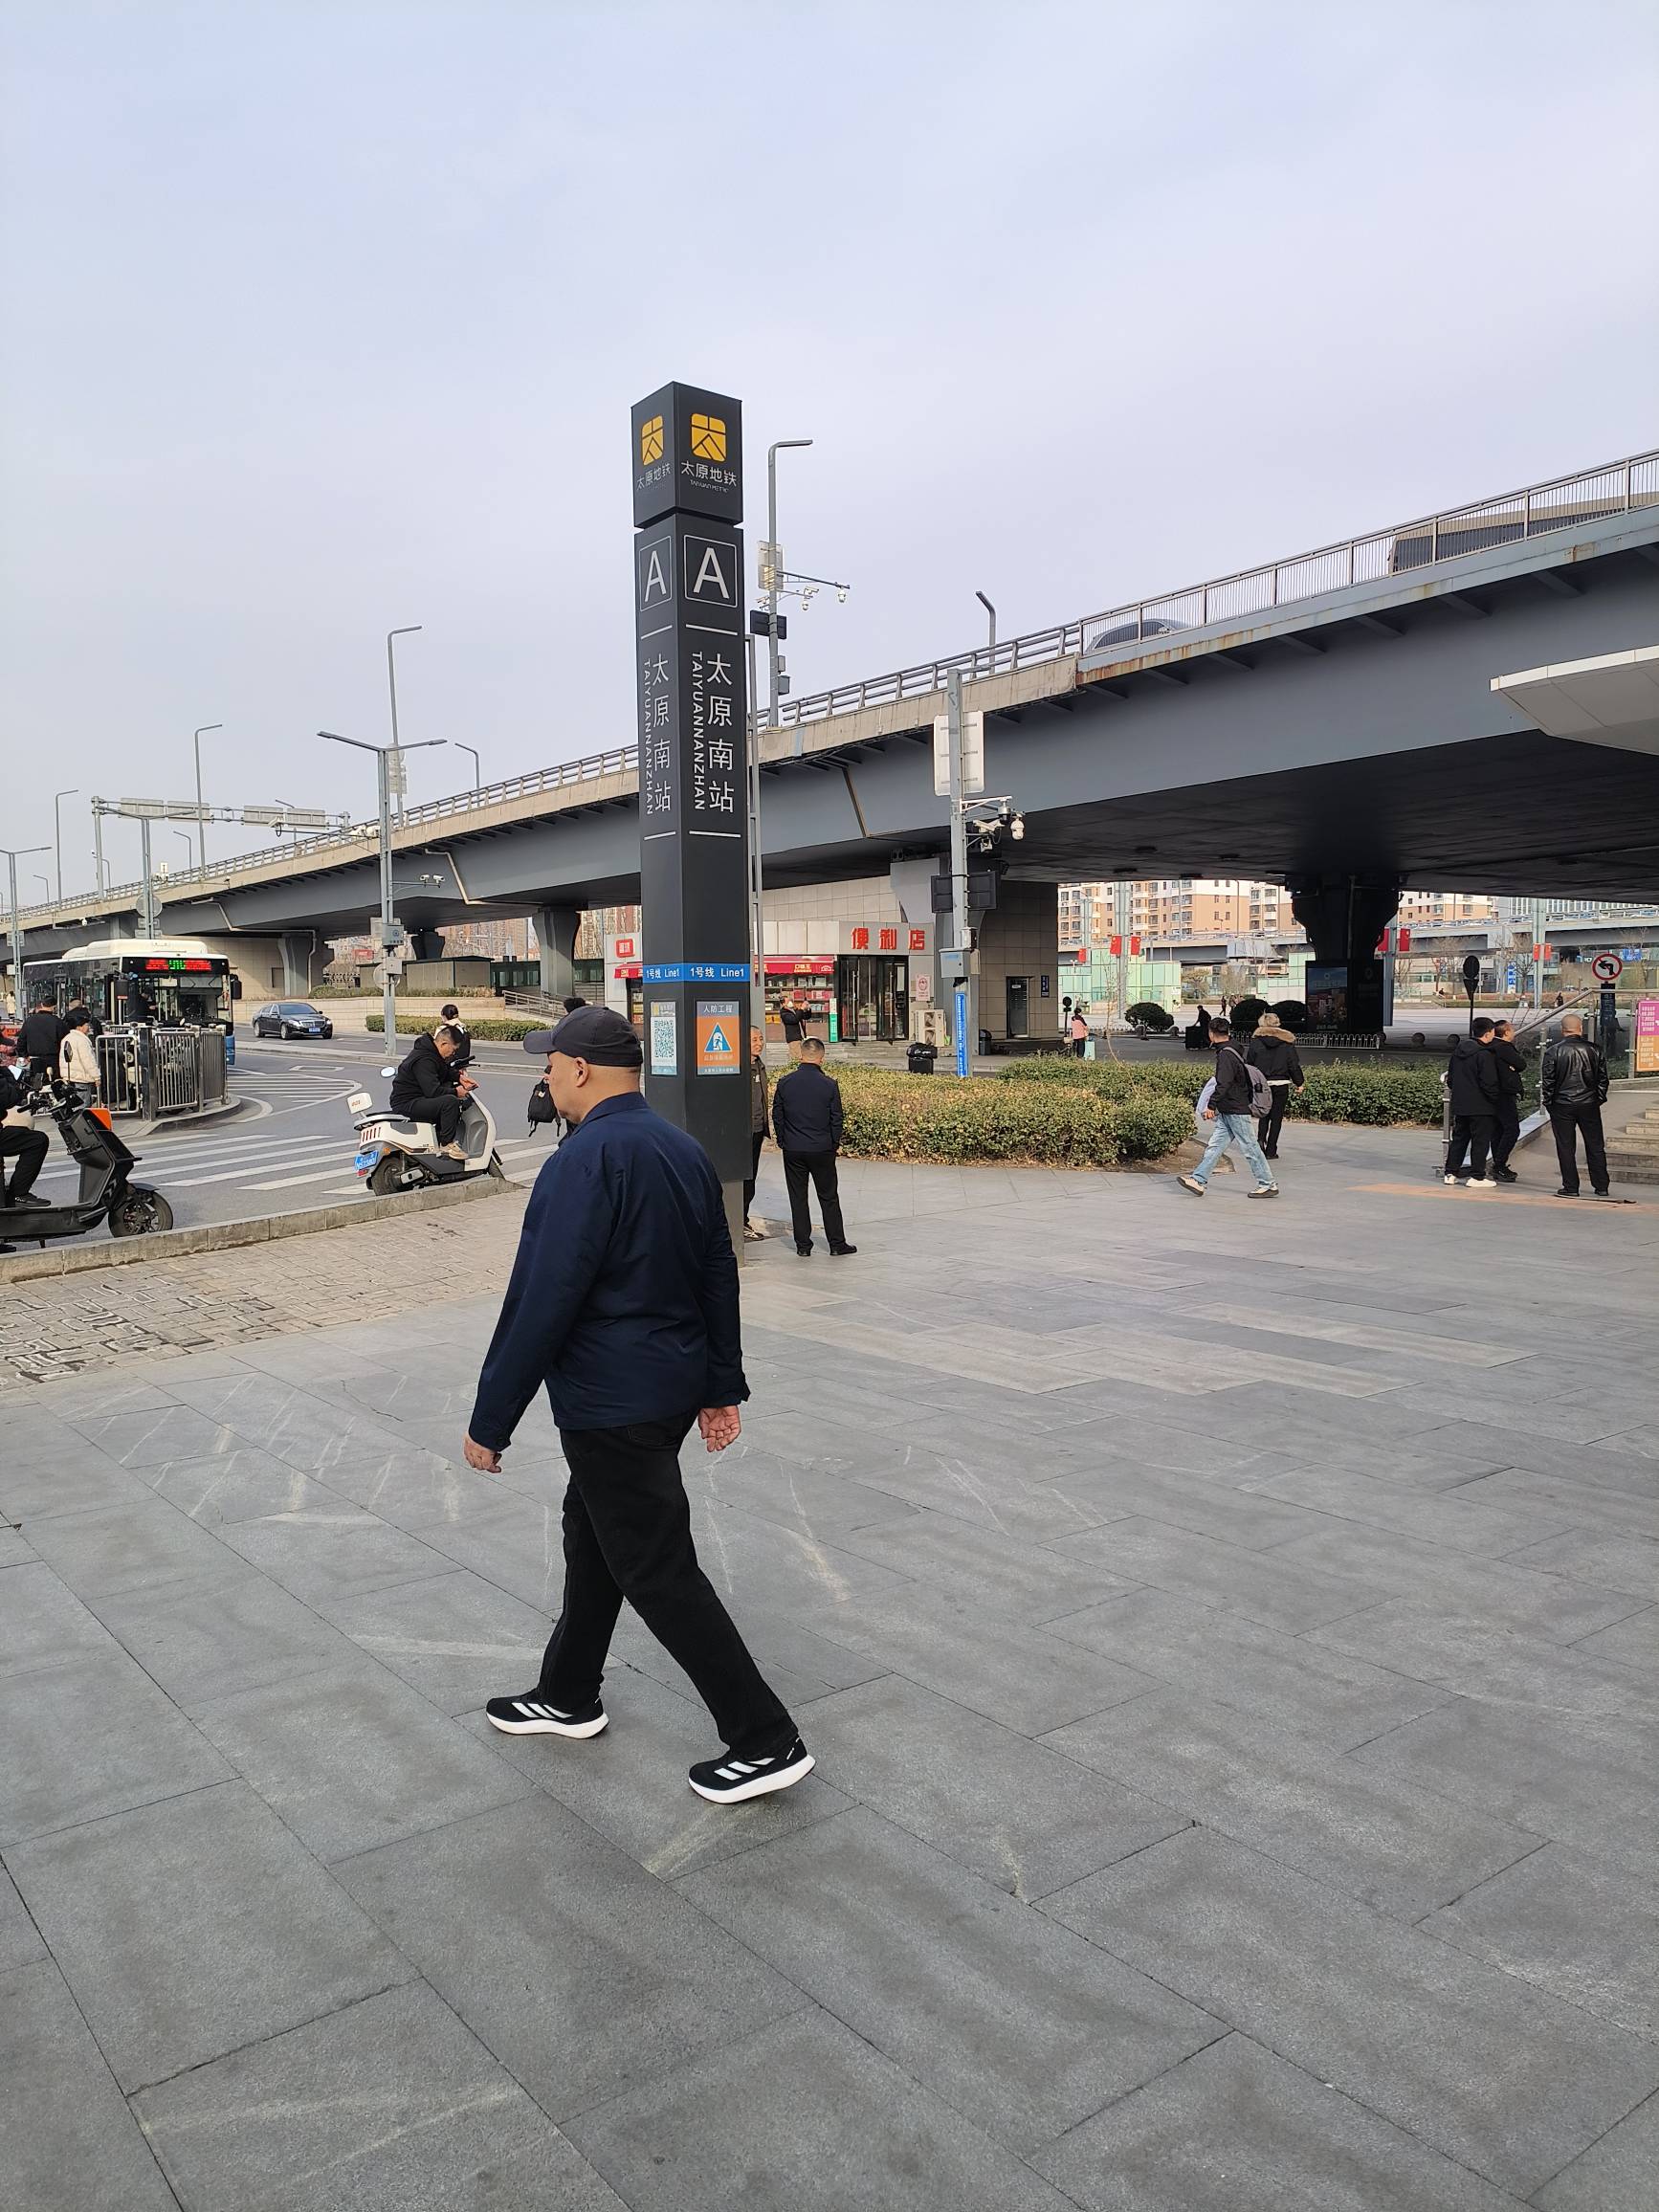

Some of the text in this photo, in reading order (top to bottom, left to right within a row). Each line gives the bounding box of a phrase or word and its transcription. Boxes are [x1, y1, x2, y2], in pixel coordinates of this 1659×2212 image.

[636, 463, 671, 491] 太原地铁
[681, 461, 737, 487] 太原地铁
[644, 550, 667, 603] A
[693, 547, 730, 600] A
[644, 658, 653, 815] TAIYUANNANZHAN
[653, 653, 672, 812] 太原南站
[692, 652, 706, 810] TAIYUANNANZHAN
[707, 653, 735, 813] 太原南站
[851, 927, 926, 951] 便利店
[646, 968, 661, 980] 1号线
[664, 967, 680, 978] Line1
[691, 967, 715, 978] 1号线
[720, 968, 744, 978] Line1
[703, 1005, 733, 1014] 人防工程
